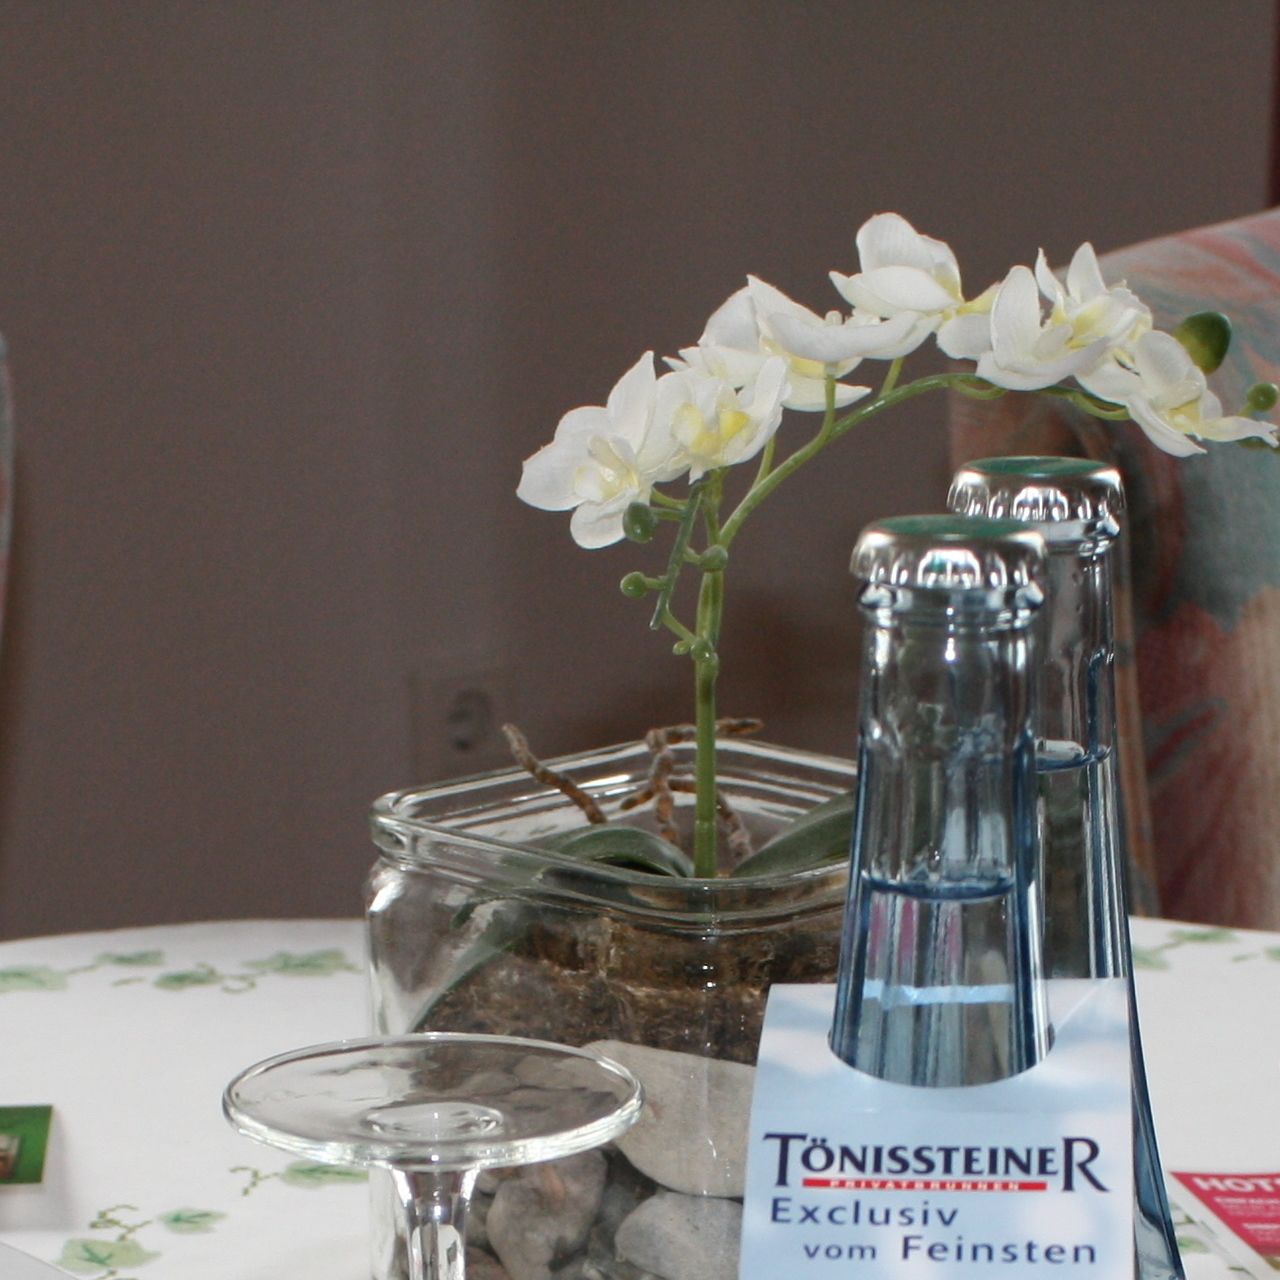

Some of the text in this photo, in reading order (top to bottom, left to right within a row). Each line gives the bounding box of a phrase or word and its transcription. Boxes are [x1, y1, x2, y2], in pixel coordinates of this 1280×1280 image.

[762, 1132, 1109, 1193] TÖNISSTEINER
[830, 1180, 1020, 1191] PRIVATBRUNNEN
[770, 1198, 959, 1226] Exclusiv
[803, 1235, 1097, 1265] vom Feinsten
